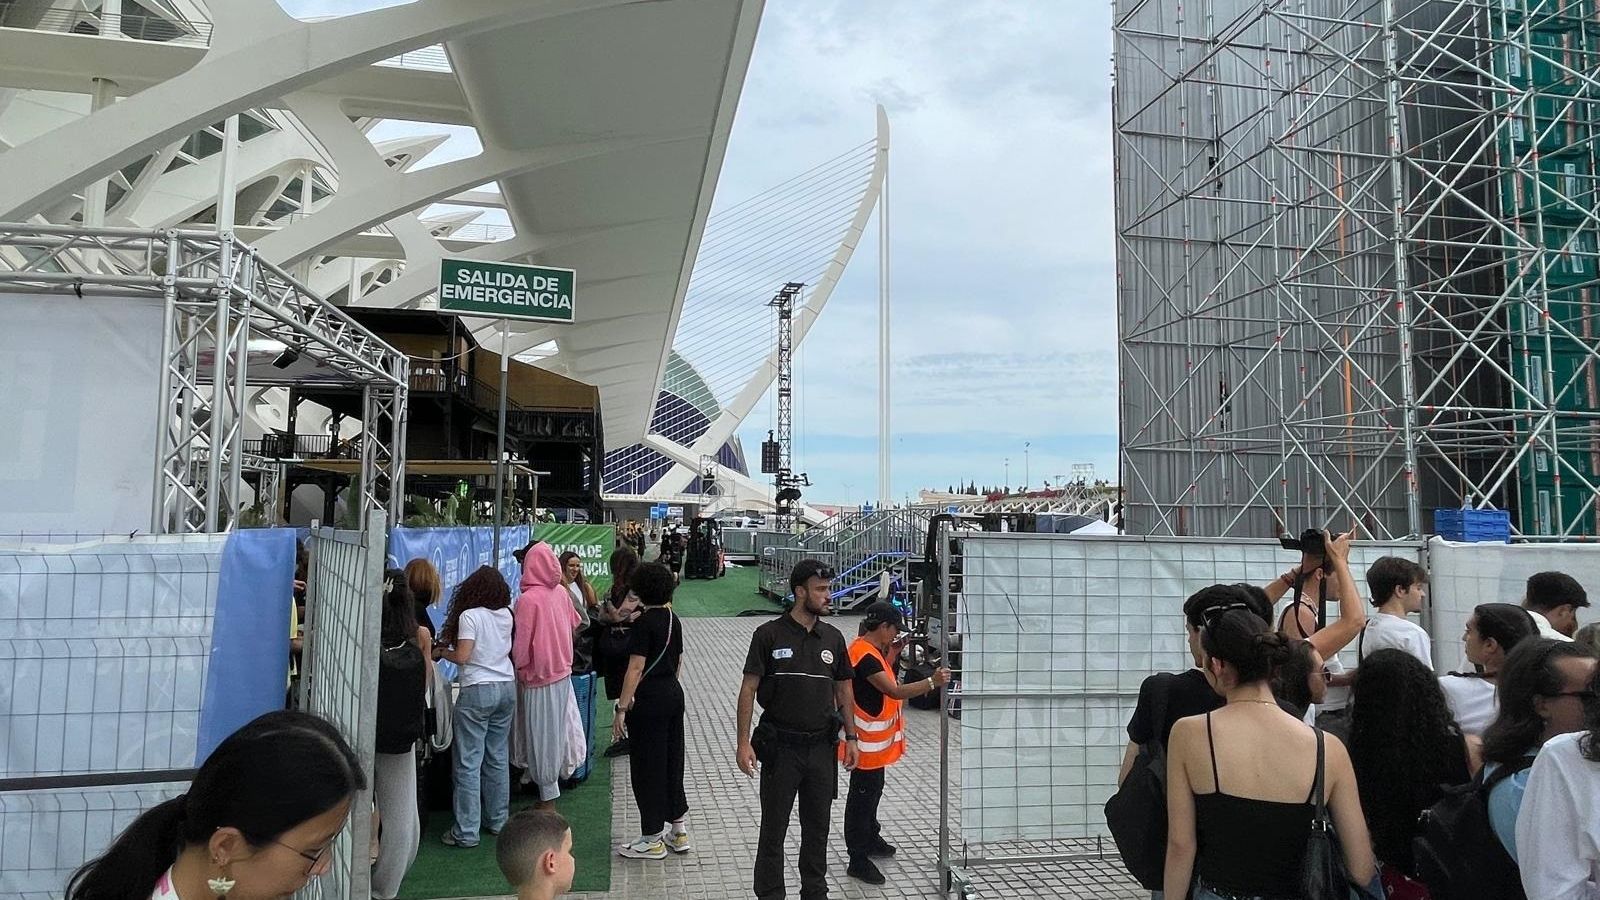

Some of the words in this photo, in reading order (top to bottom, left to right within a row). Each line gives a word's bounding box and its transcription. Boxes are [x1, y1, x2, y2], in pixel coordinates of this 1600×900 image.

[457, 268, 528, 289] SALIDA
[532, 275, 559, 292] DE
[441, 283, 572, 310] EMERGENCIA
[549, 543, 586, 558] ALIDA
[587, 544, 603, 558] DE
